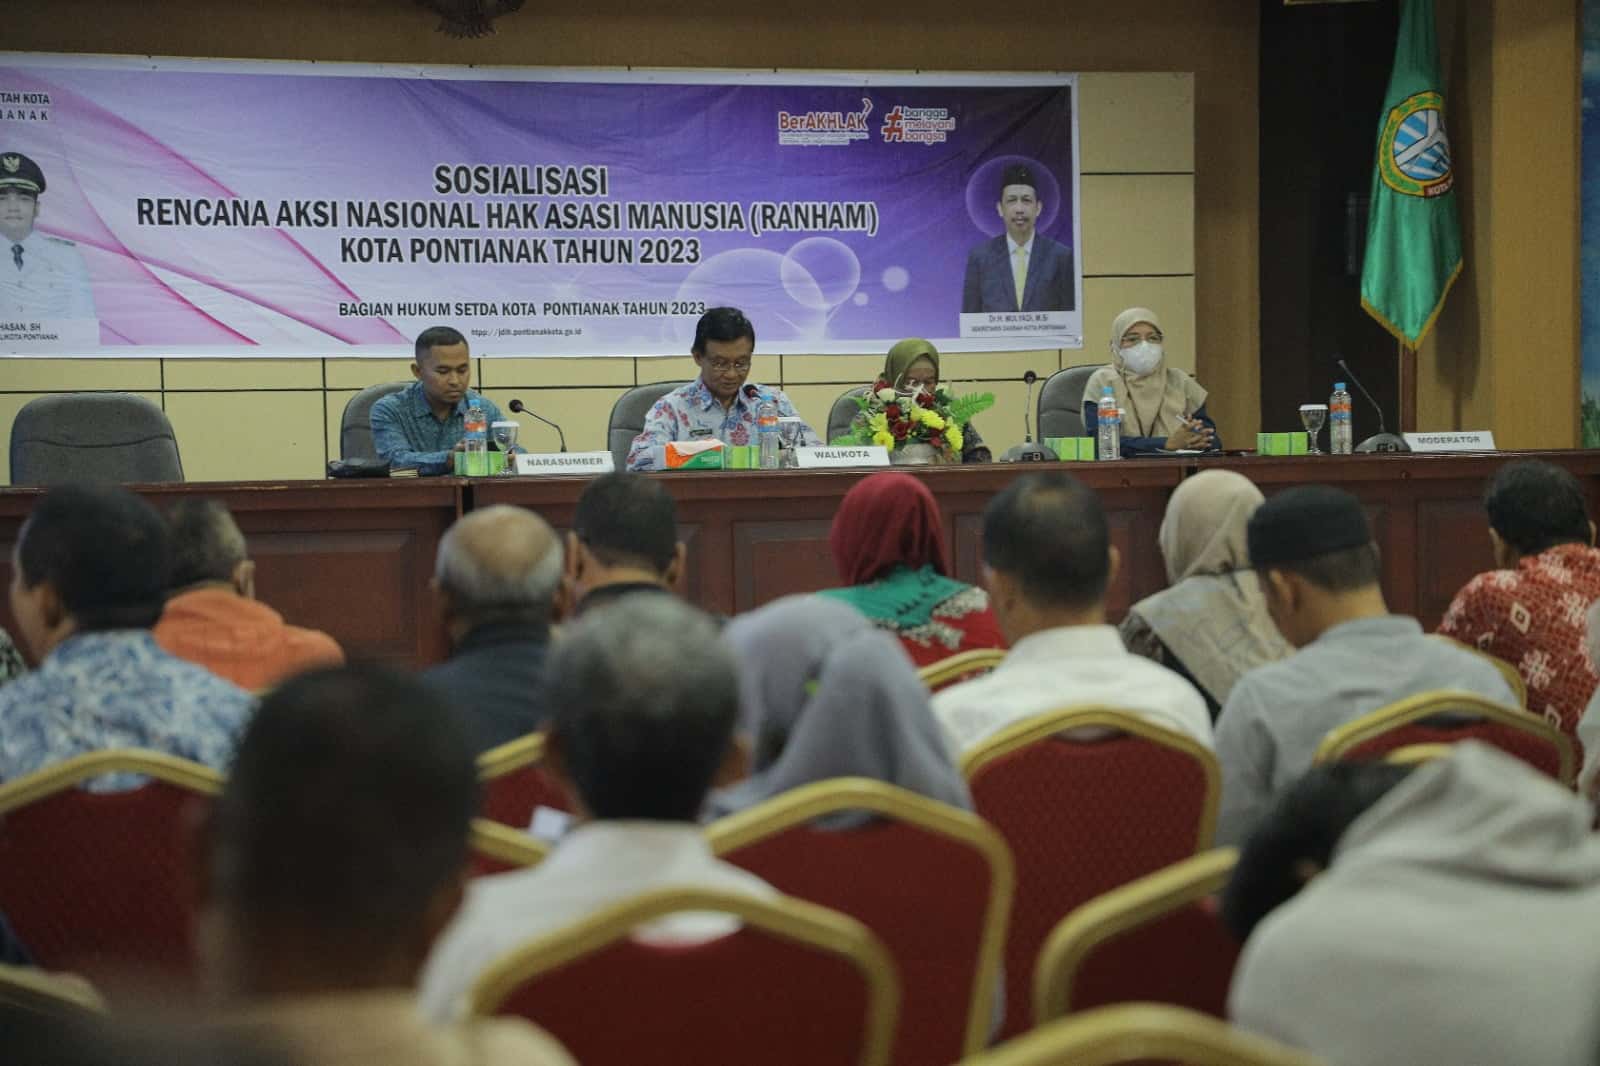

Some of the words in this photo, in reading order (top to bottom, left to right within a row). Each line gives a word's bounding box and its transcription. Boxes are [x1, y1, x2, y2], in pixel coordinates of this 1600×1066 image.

[23, 94, 50, 104] KOTA
[904, 107, 947, 119] bangga
[779, 112, 867, 130] BerAKHLAK
[904, 119, 955, 131] melayani
[904, 131, 945, 144] bangsa
[435, 165, 607, 195] SOSIALISASI
[136, 198, 270, 227] RENCANA
[276, 201, 338, 228] AKSI
[347, 201, 480, 229] NASIONAL
[487, 203, 539, 229] HAK
[544, 203, 620, 230] ASASI
[628, 203, 745, 230] MANUSIA
[751, 204, 878, 236] (RANHAM)
[341, 237, 404, 264] KOTA
[411, 238, 549, 264] PONTIANAK
[553, 238, 634, 264] TAHUN
[639, 238, 701, 264] 2023
[339, 302, 394, 317] BAGIAN
[397, 302, 451, 317] HUKUM
[454, 302, 499, 316] SETDA
[502, 302, 537, 316] KOTA
[543, 302, 620, 316] PONTIANAK
[622, 302, 668, 316] TAHUN
[671, 301, 706, 315] 2023
[1416, 435, 1481, 445] MODERATOR
[814, 449, 871, 460] WALIKOTA
[527, 456, 604, 467] NARASUMBER
